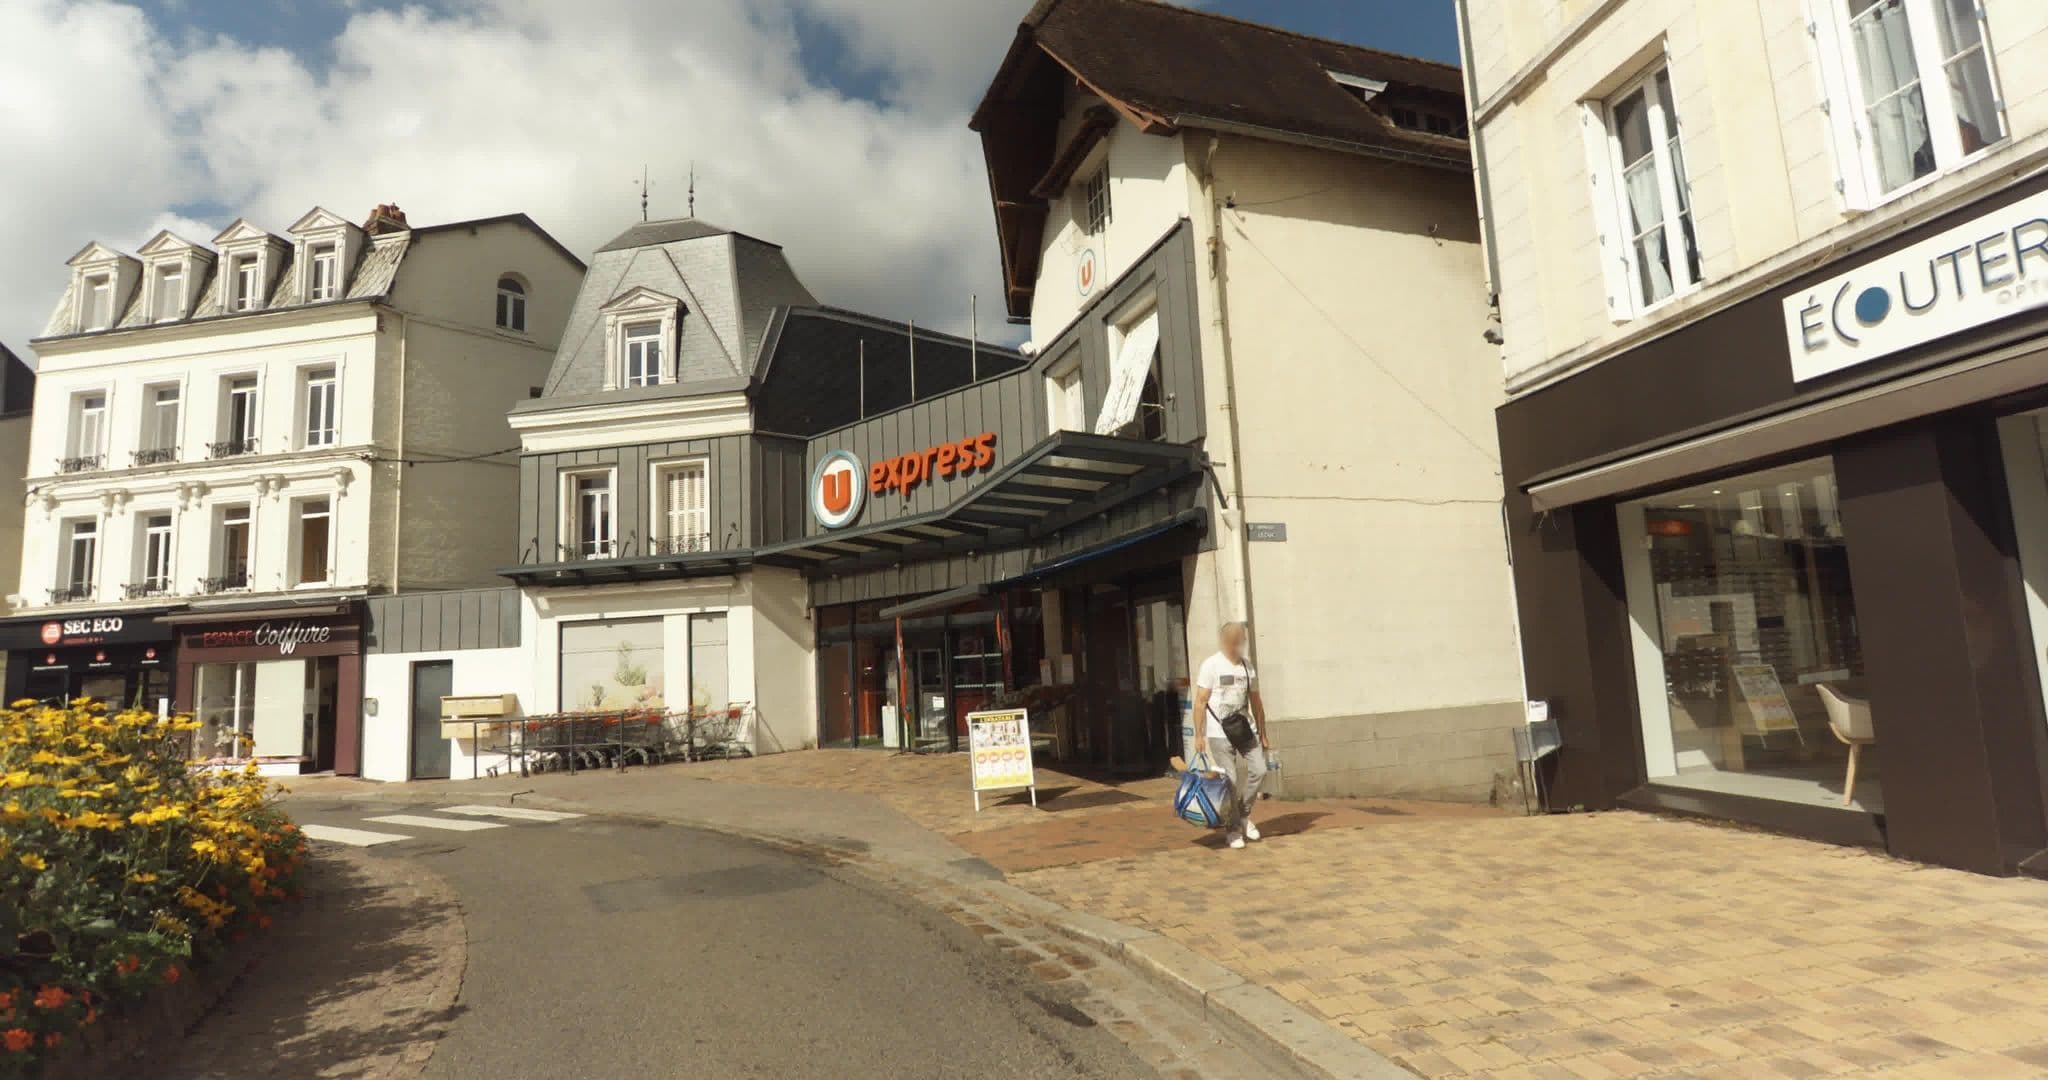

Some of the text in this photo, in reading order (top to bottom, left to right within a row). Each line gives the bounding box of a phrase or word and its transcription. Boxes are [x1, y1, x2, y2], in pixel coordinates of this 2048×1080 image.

[1081, 259, 1092, 287] U
[822, 431, 998, 513] U express
[63, 617, 123, 635] SEC ECO
[203, 621, 330, 655] ESPACE Coiffure
